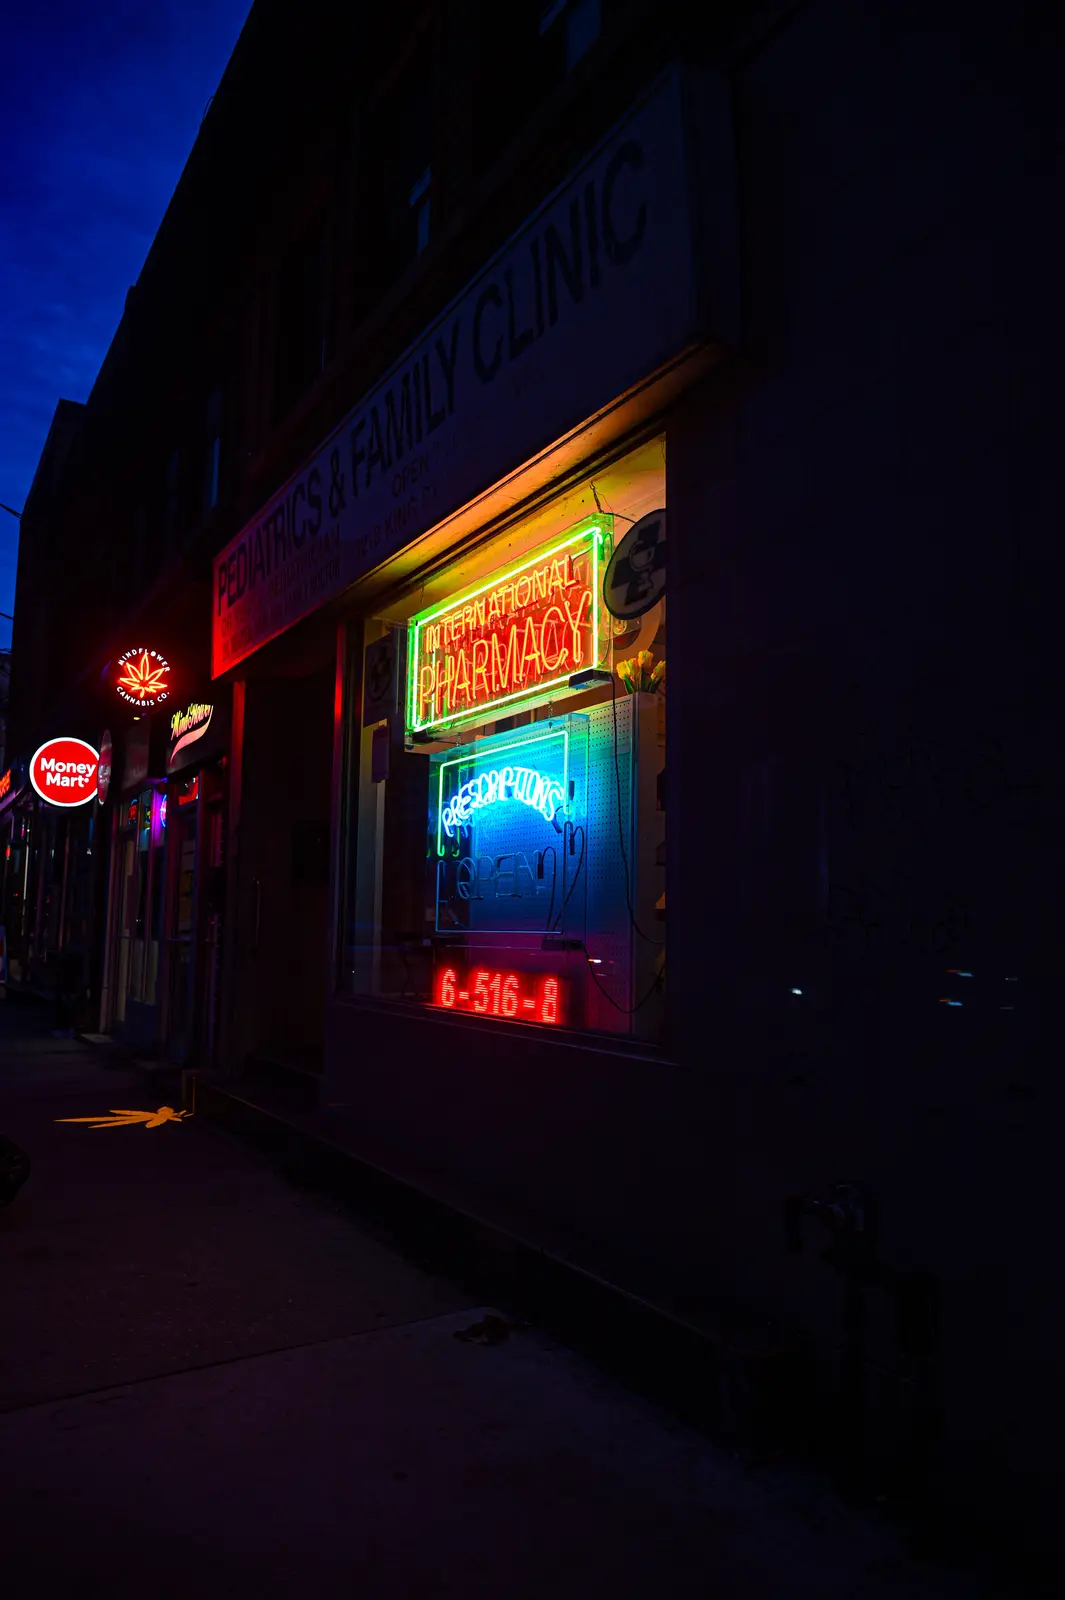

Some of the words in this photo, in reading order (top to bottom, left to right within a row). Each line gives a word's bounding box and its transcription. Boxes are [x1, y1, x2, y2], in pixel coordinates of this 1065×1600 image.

[217, 467, 322, 617] PEDIATRICS
[329, 449, 346, 518] &
[350, 318, 460, 498] FAMILY
[472, 140, 648, 384] CLINIC
[391, 450, 429, 498] OPEN
[425, 554, 580, 654] INTERNATIONAL
[117, 647, 171, 673] MINDFLOWER
[419, 590, 593, 720] PHARMACY
[116, 686, 155, 707] CANNABIS
[157, 691, 170, 704] CO.
[40, 757, 97, 778] Money
[45, 772, 86, 788] Mart
[441, 765, 566, 838] PRESCRIPTIONS
